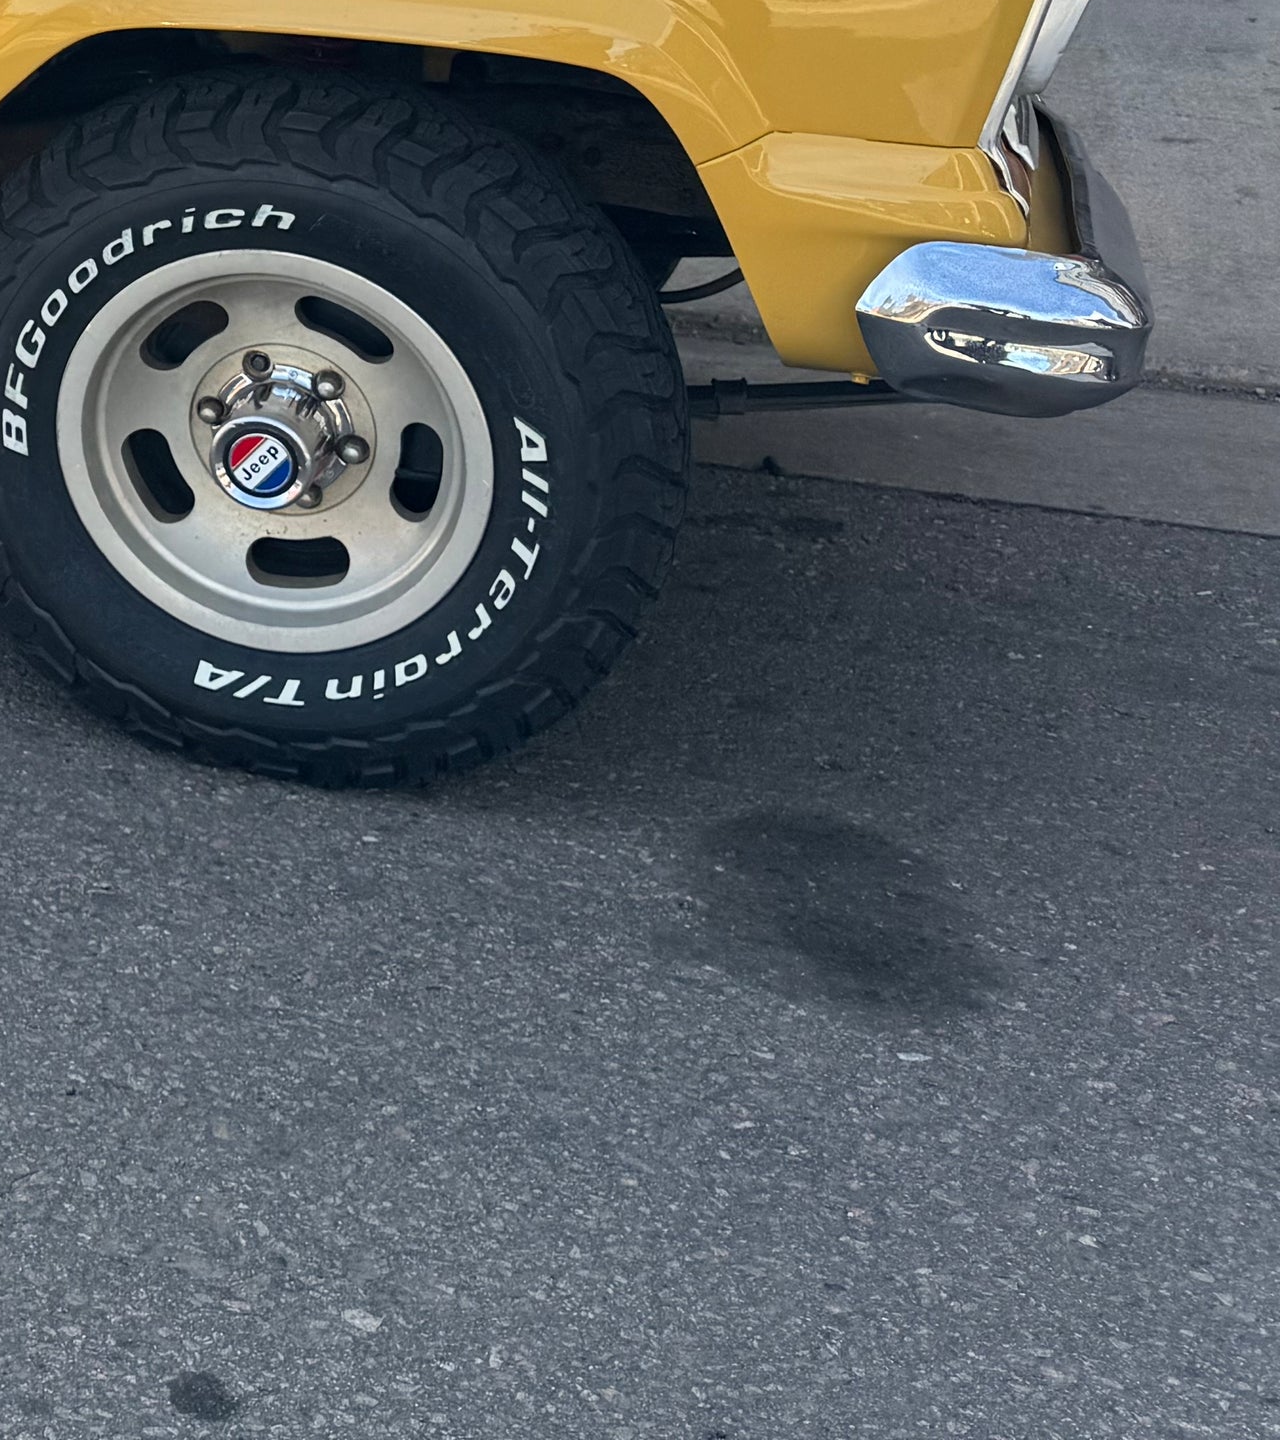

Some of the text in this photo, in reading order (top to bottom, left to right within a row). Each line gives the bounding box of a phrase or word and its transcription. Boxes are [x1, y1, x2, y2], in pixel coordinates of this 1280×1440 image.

[1, 203, 296, 457] BFGoodrich
[242, 445, 280, 482] Jeep
[325, 416, 550, 701] All-Terrain
[193, 659, 305, 707] T/A
